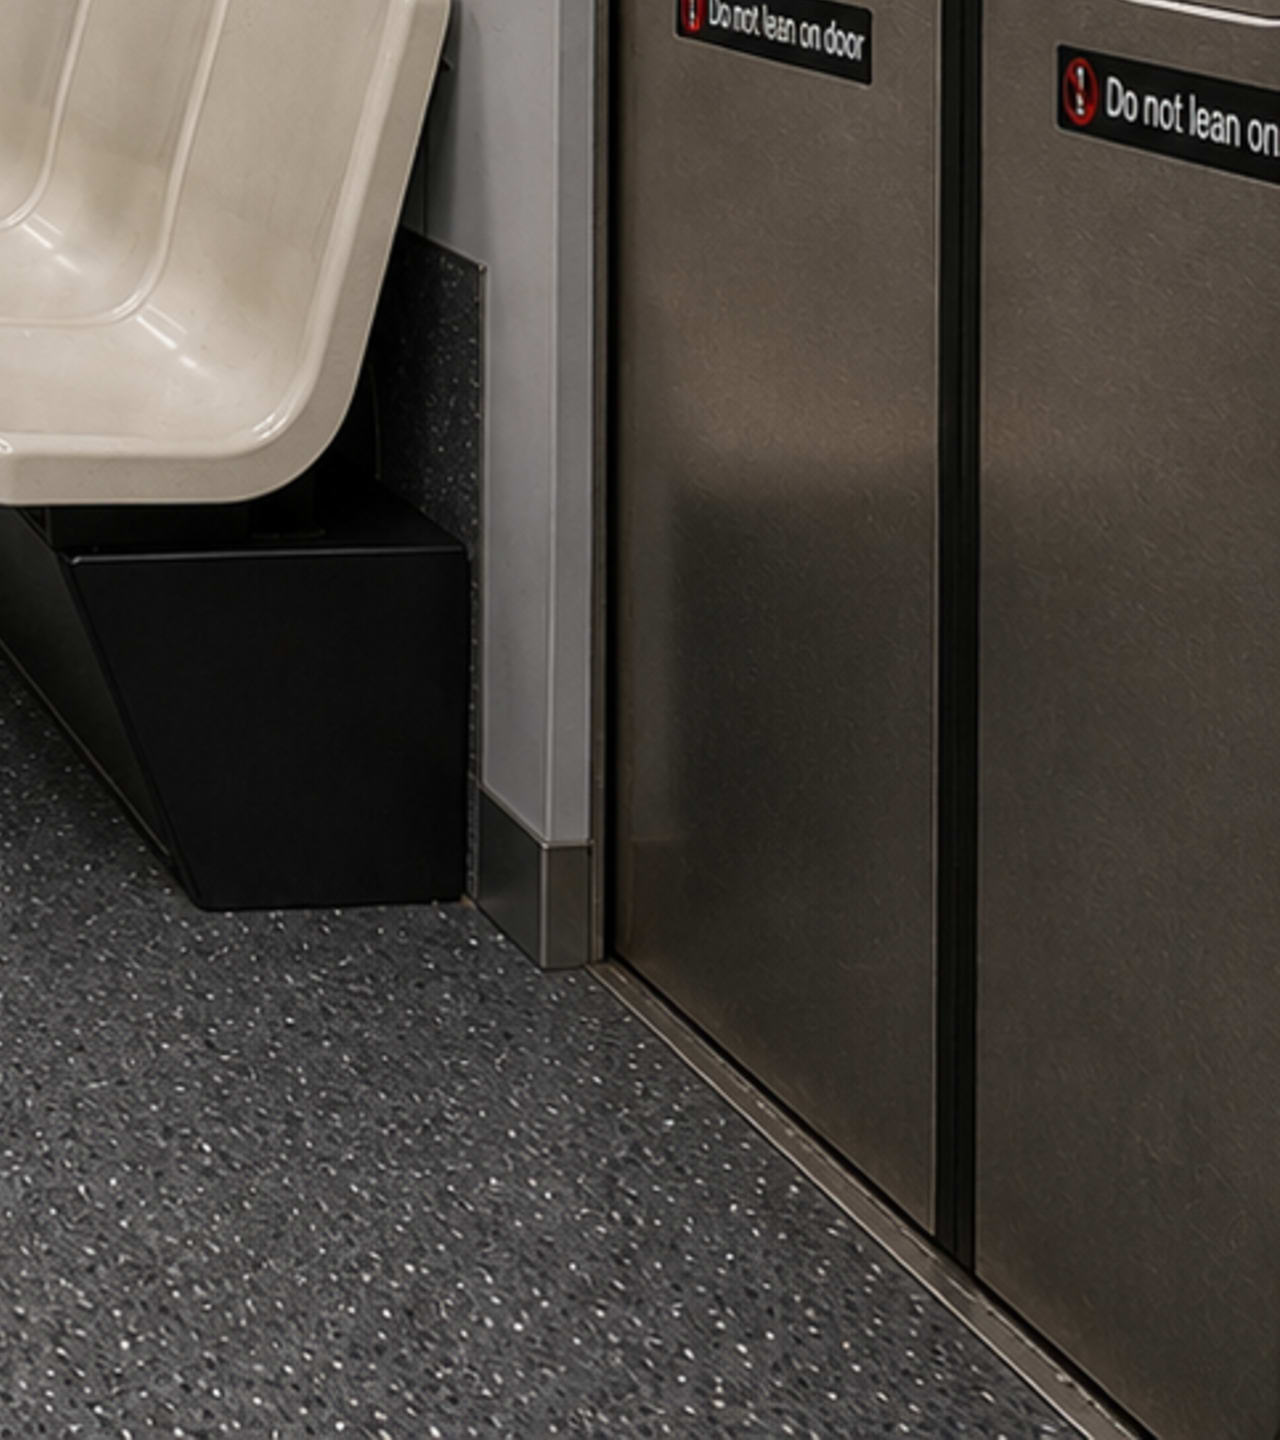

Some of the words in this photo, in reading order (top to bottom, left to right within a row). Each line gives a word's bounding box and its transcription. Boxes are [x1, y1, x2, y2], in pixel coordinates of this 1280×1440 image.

[823, 20, 865, 60] door
[1107, 76, 1138, 122] Do
[1144, 93, 1183, 133] not
[1190, 94, 1240, 147] lean
[1247, 118, 1280, 157] on
